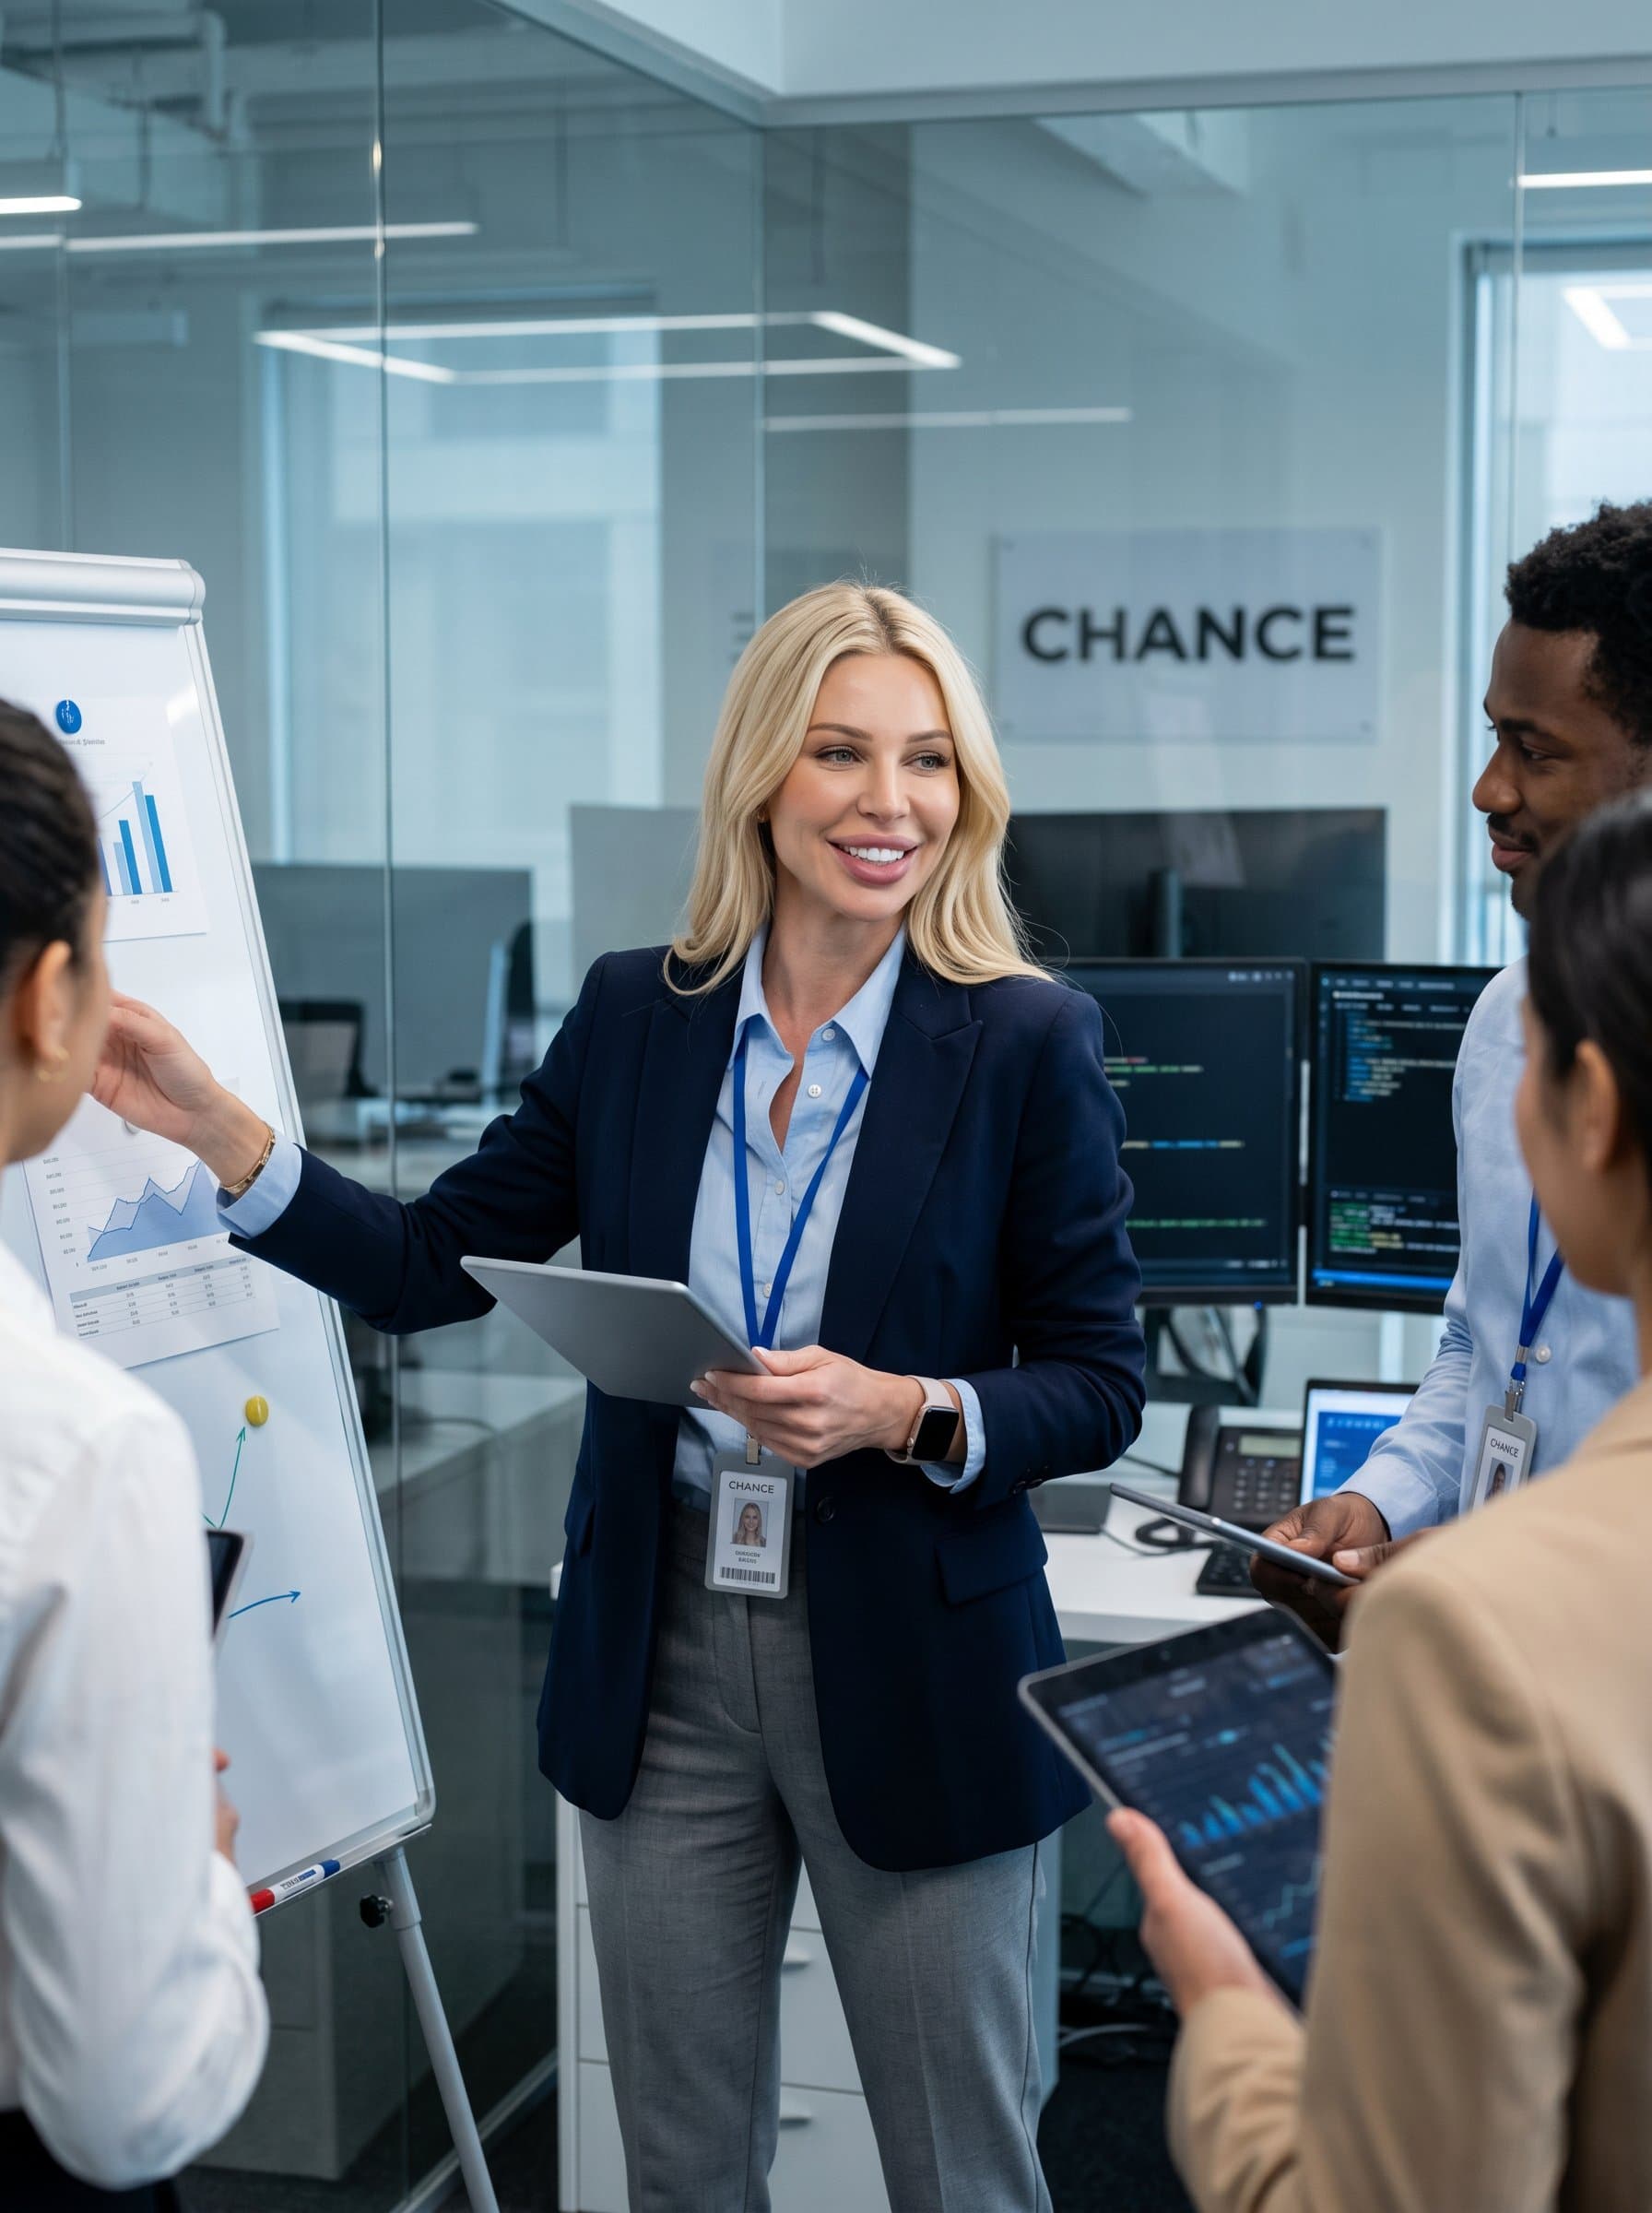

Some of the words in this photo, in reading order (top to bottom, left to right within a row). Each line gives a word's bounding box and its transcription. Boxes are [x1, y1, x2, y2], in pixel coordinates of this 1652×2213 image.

[1021, 605, 1356, 663] CHANCE
[1490, 1438, 1519, 1458] CHANCE
[728, 1481, 774, 1494] CHANCE
